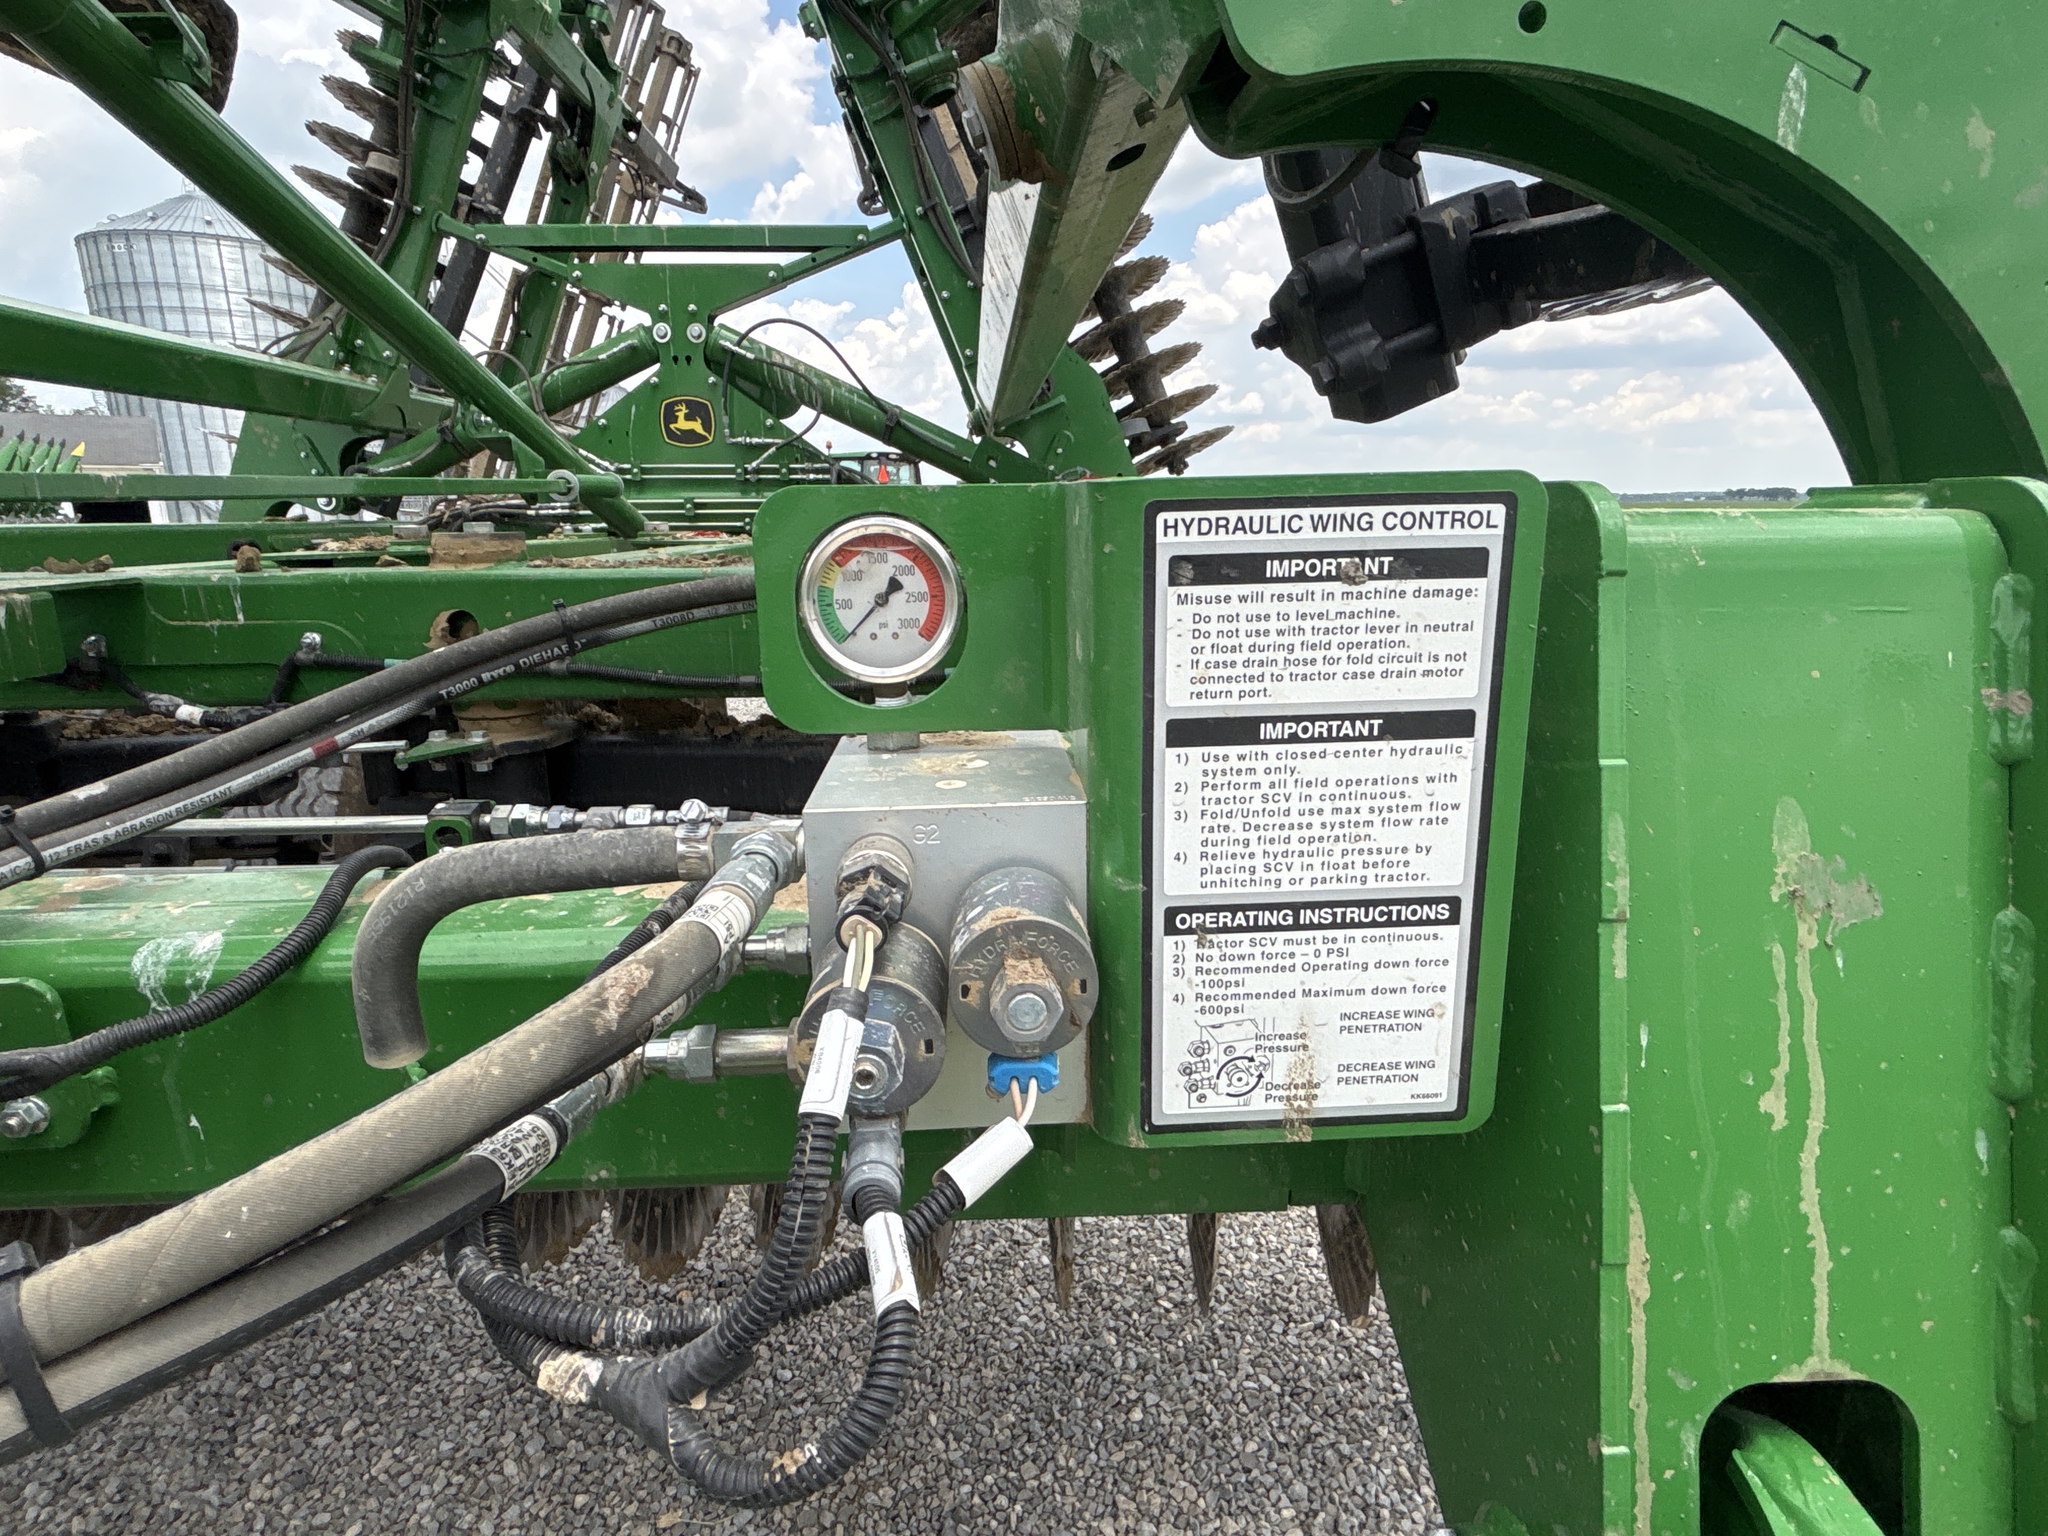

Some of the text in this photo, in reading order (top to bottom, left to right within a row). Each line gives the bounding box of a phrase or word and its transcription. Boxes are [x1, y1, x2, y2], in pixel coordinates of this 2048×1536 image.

[1163, 510, 1498, 537] HYDRAULIC WING CONTROL
[892, 565, 915, 577] 2000
[1266, 556, 1393, 579] IMPORTNT
[835, 599, 853, 610] 500
[905, 591, 929, 603] 2500
[1177, 586, 1478, 606] Misuse will result in machine damage:
[897, 617, 920, 629] 3000
[1192, 607, 1400, 624] Do not use to level machine.
[878, 620, 888, 631] psi
[1192, 620, 1474, 640] Do not use with tractor lever in neutral
[1190, 637, 1410, 655] or float during field operation.
[1191, 651, 1467, 670] If case drain hose for fold circuit is not
[1190, 667, 1464, 685] connected to tractor case drain motor
[438, 677, 478, 700] T3000
[1190, 687, 1272, 701] return port.
[1260, 719, 1383, 740] IMPORTANT
[1175, 752, 1189, 766] 1)
[1201, 752, 1230, 763] Use
[1236, 750, 1269, 761] with
[1390, 743, 1463, 757] hydraulic
[1202, 764, 1300, 780] system only.
[1174, 772, 1457, 795] 2) Perform all field operations with
[1201, 790, 1411, 806] tractor SCV in continuous.
[1174, 801, 1461, 823] 3) Fold/Unfold use max system flow
[66, 785, 234, 857] FRAS & ABRASION RESISTANT
[1201, 815, 1449, 834] rate. Decrease system flow rate
[1200, 832, 1376, 849] during field operation.
[1173, 843, 1432, 865] 4) Relieve hydraulic pressure by
[1200, 858, 1410, 878] placing SCV in float before
[1200, 872, 1430, 889] unhitching or parking tractor.
[1175, 903, 1450, 929] OPERATING INSTRUCTIONS
[1173, 940, 1186, 953] 1)
[1249, 937, 1278, 948] SCV
[1283, 936, 1317, 946] must
[1322, 935, 1338, 945] be
[1344, 934, 1356, 944] in
[1361, 932, 1443, 944] continuous.
[1173, 947, 1349, 966] 2) No down force 0 PSI
[1173, 957, 1449, 979] 3) Recommended Operating down force
[1195, 977, 1245, 991] -100psi
[1172, 984, 1446, 1006] 4) Recommended Maximum down force
[1194, 1003, 1244, 1017] -600psi
[1340, 1008, 1435, 1021] INCREASE WING
[1255, 1031, 1307, 1042] Increase
[1339, 1022, 1422, 1035] PENETRATION
[1255, 1042, 1309, 1054] Pressure
[1337, 1059, 1435, 1073] DECREASE WING
[1265, 1080, 1321, 1092] Decrease
[1337, 1073, 1419, 1086] PENETRATION
[1265, 1092, 1319, 1103] Pressure
